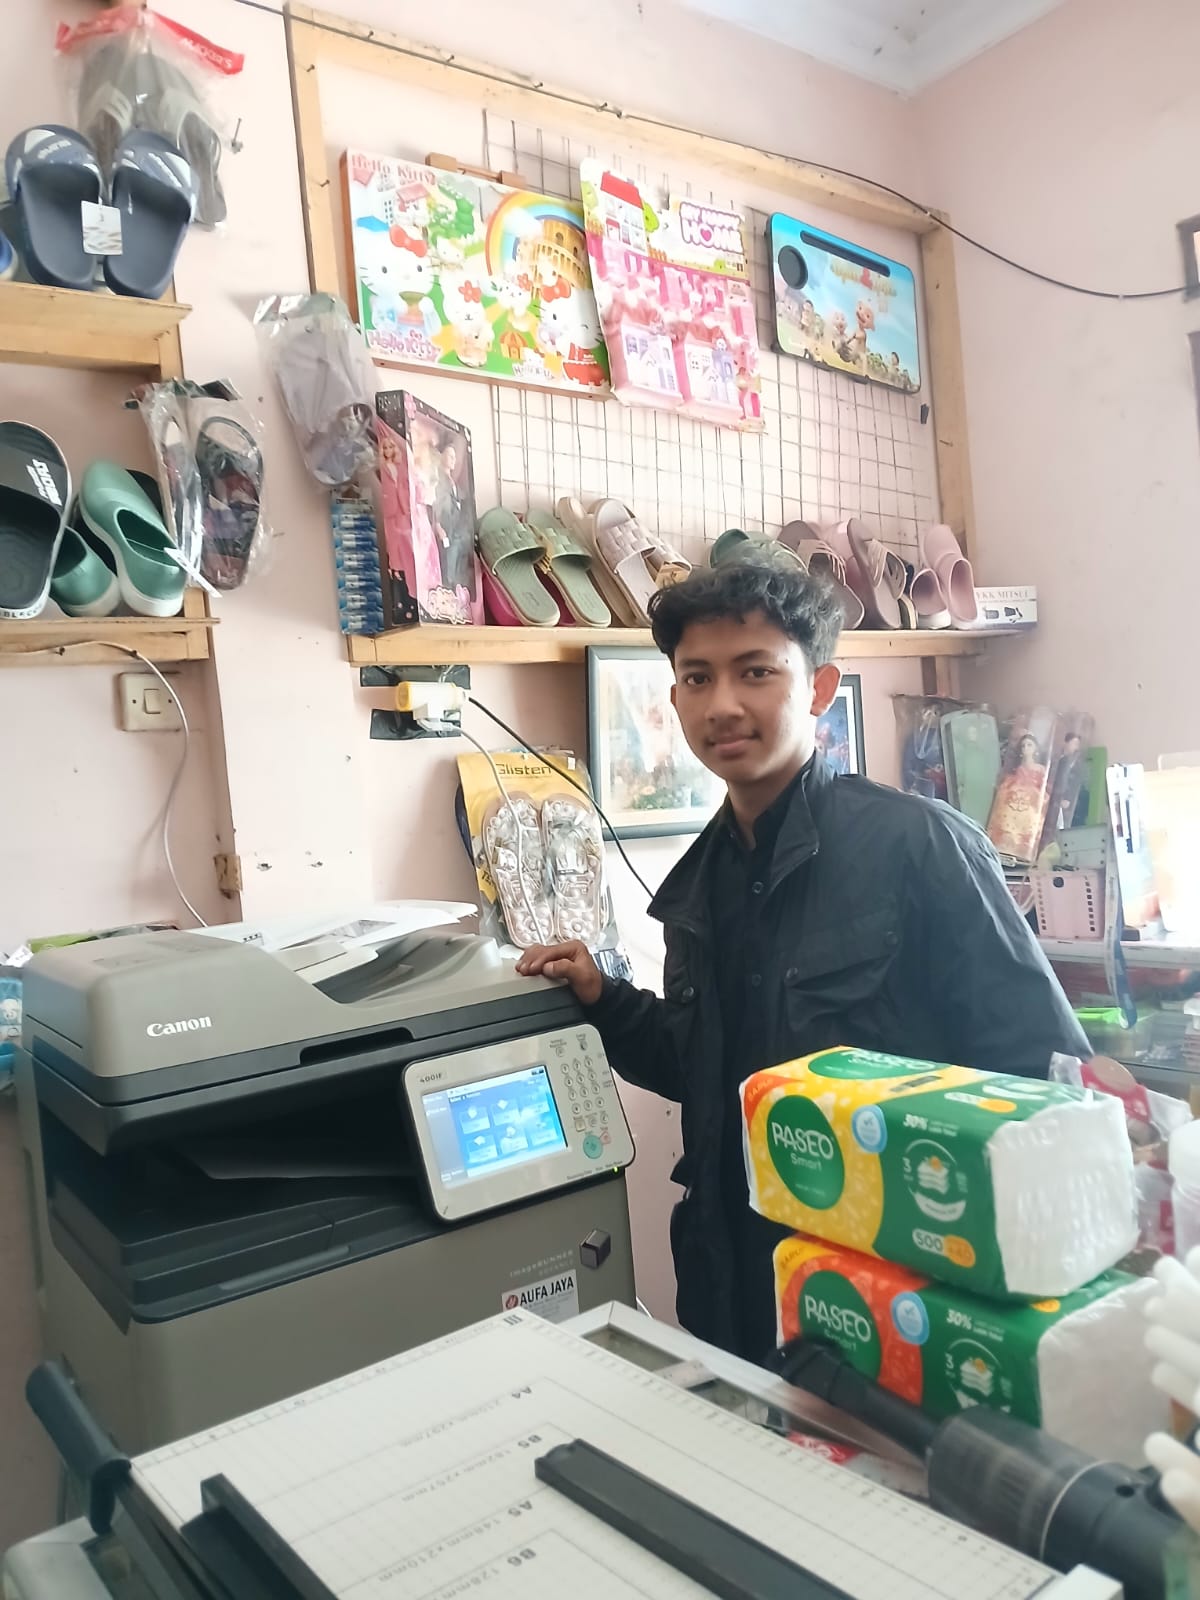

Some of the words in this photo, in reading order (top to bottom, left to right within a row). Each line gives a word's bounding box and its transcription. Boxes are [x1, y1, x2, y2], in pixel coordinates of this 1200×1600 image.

[146, 1016, 212, 1037] Canon
[771, 1121, 835, 1160] PASEO
[790, 1153, 823, 1171] Smart
[520, 1285, 548, 1306] AUFA
[549, 1276, 574, 1296] JAYA
[804, 1295, 871, 1343] PASEO
[517, 1434, 543, 1449] B5
[507, 1500, 533, 1518] A5
[507, 1548, 537, 1567] B6
